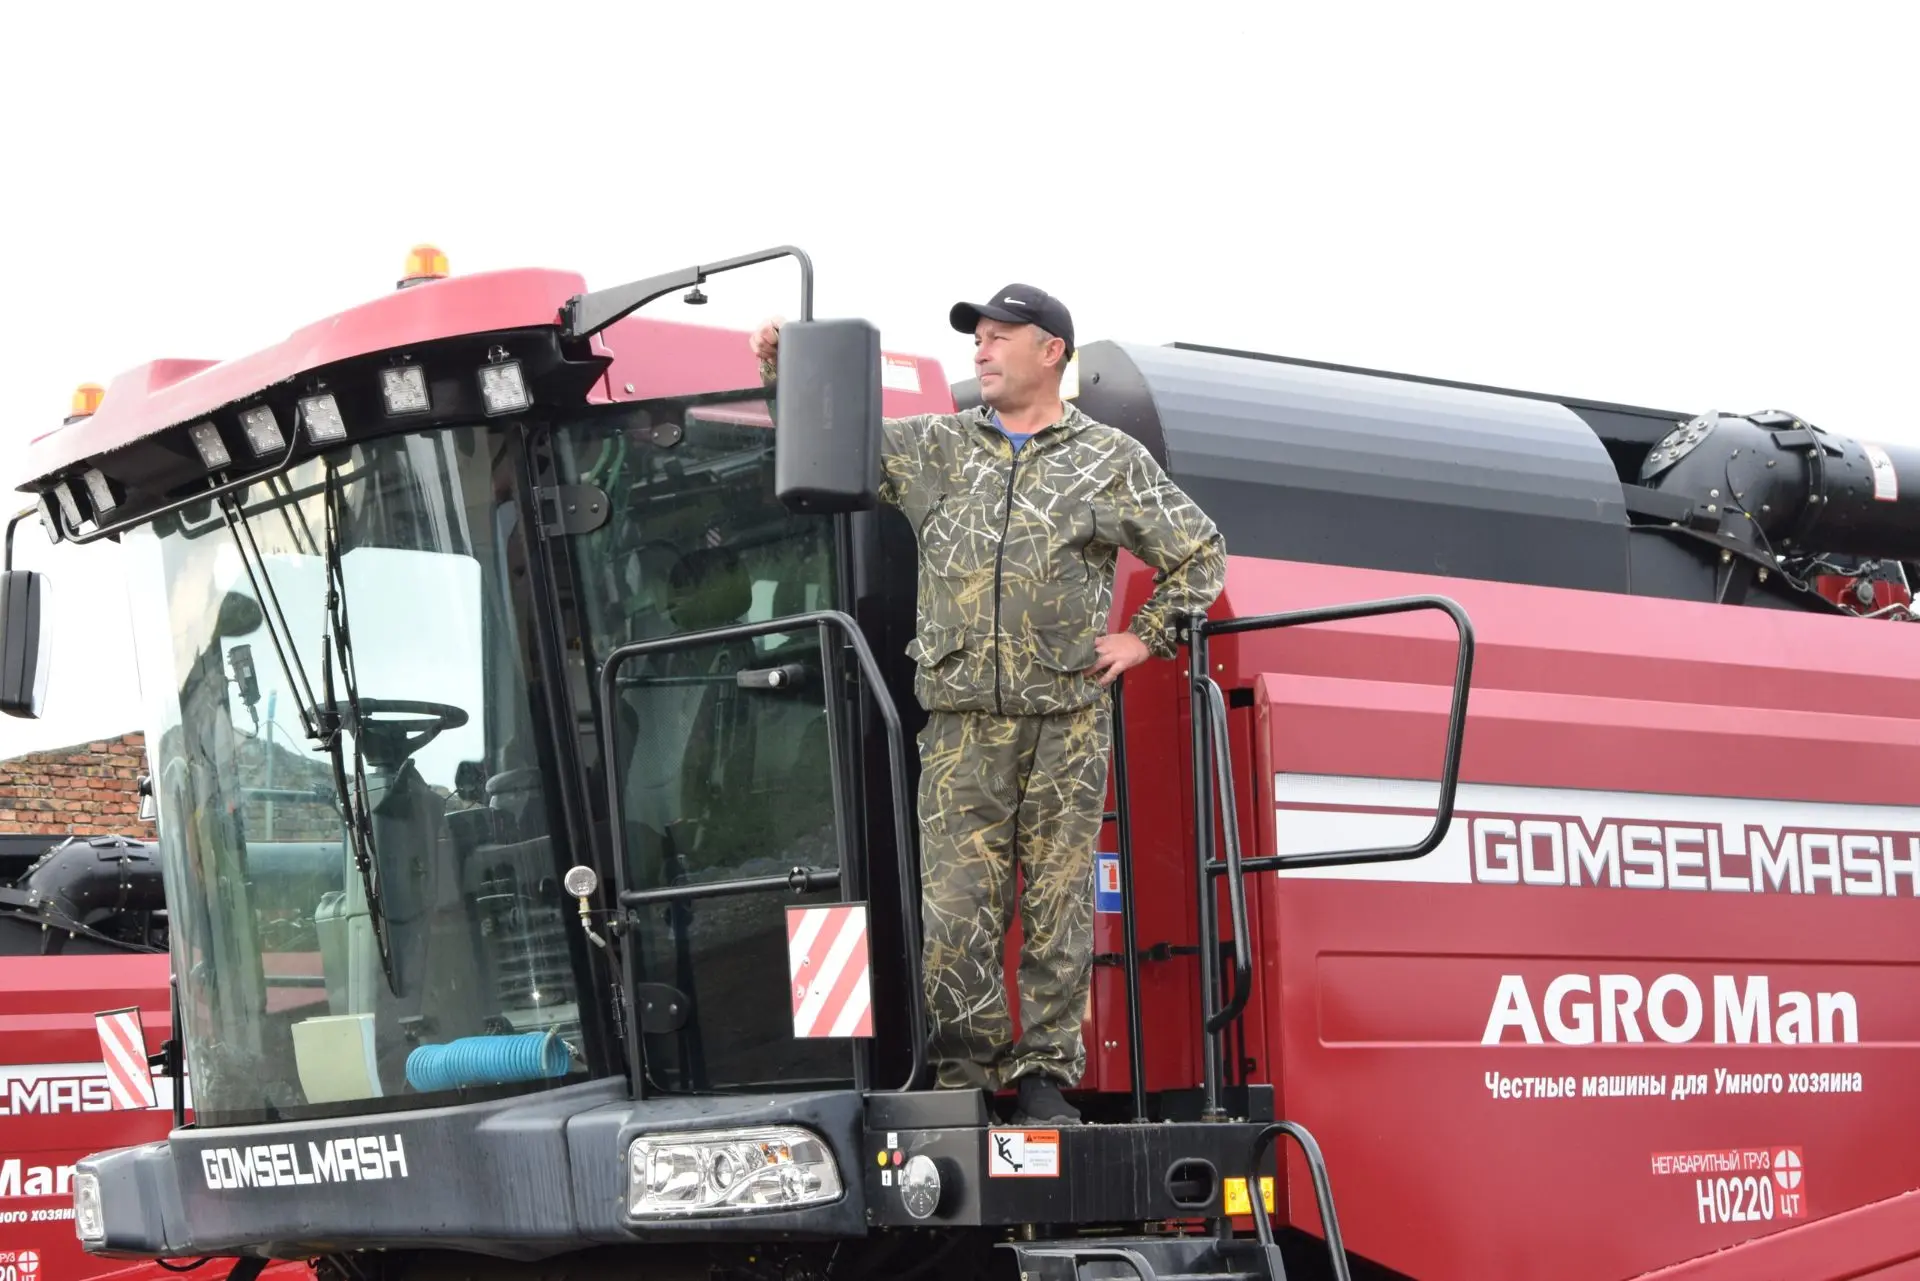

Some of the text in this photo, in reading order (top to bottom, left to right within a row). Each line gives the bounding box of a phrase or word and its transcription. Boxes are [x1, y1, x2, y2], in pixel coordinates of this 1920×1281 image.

[1473, 816, 1920, 897] GOMSELMASH
[1484, 1067, 1862, 1101] Честные машины для Умного хозяина
[201, 1134, 408, 1189] GOMSELMASH
[1651, 1149, 1771, 1175] НЕГАБАРИТНЫЙ ГРУЗ
[1780, 1193, 1800, 1218] ЦТ
